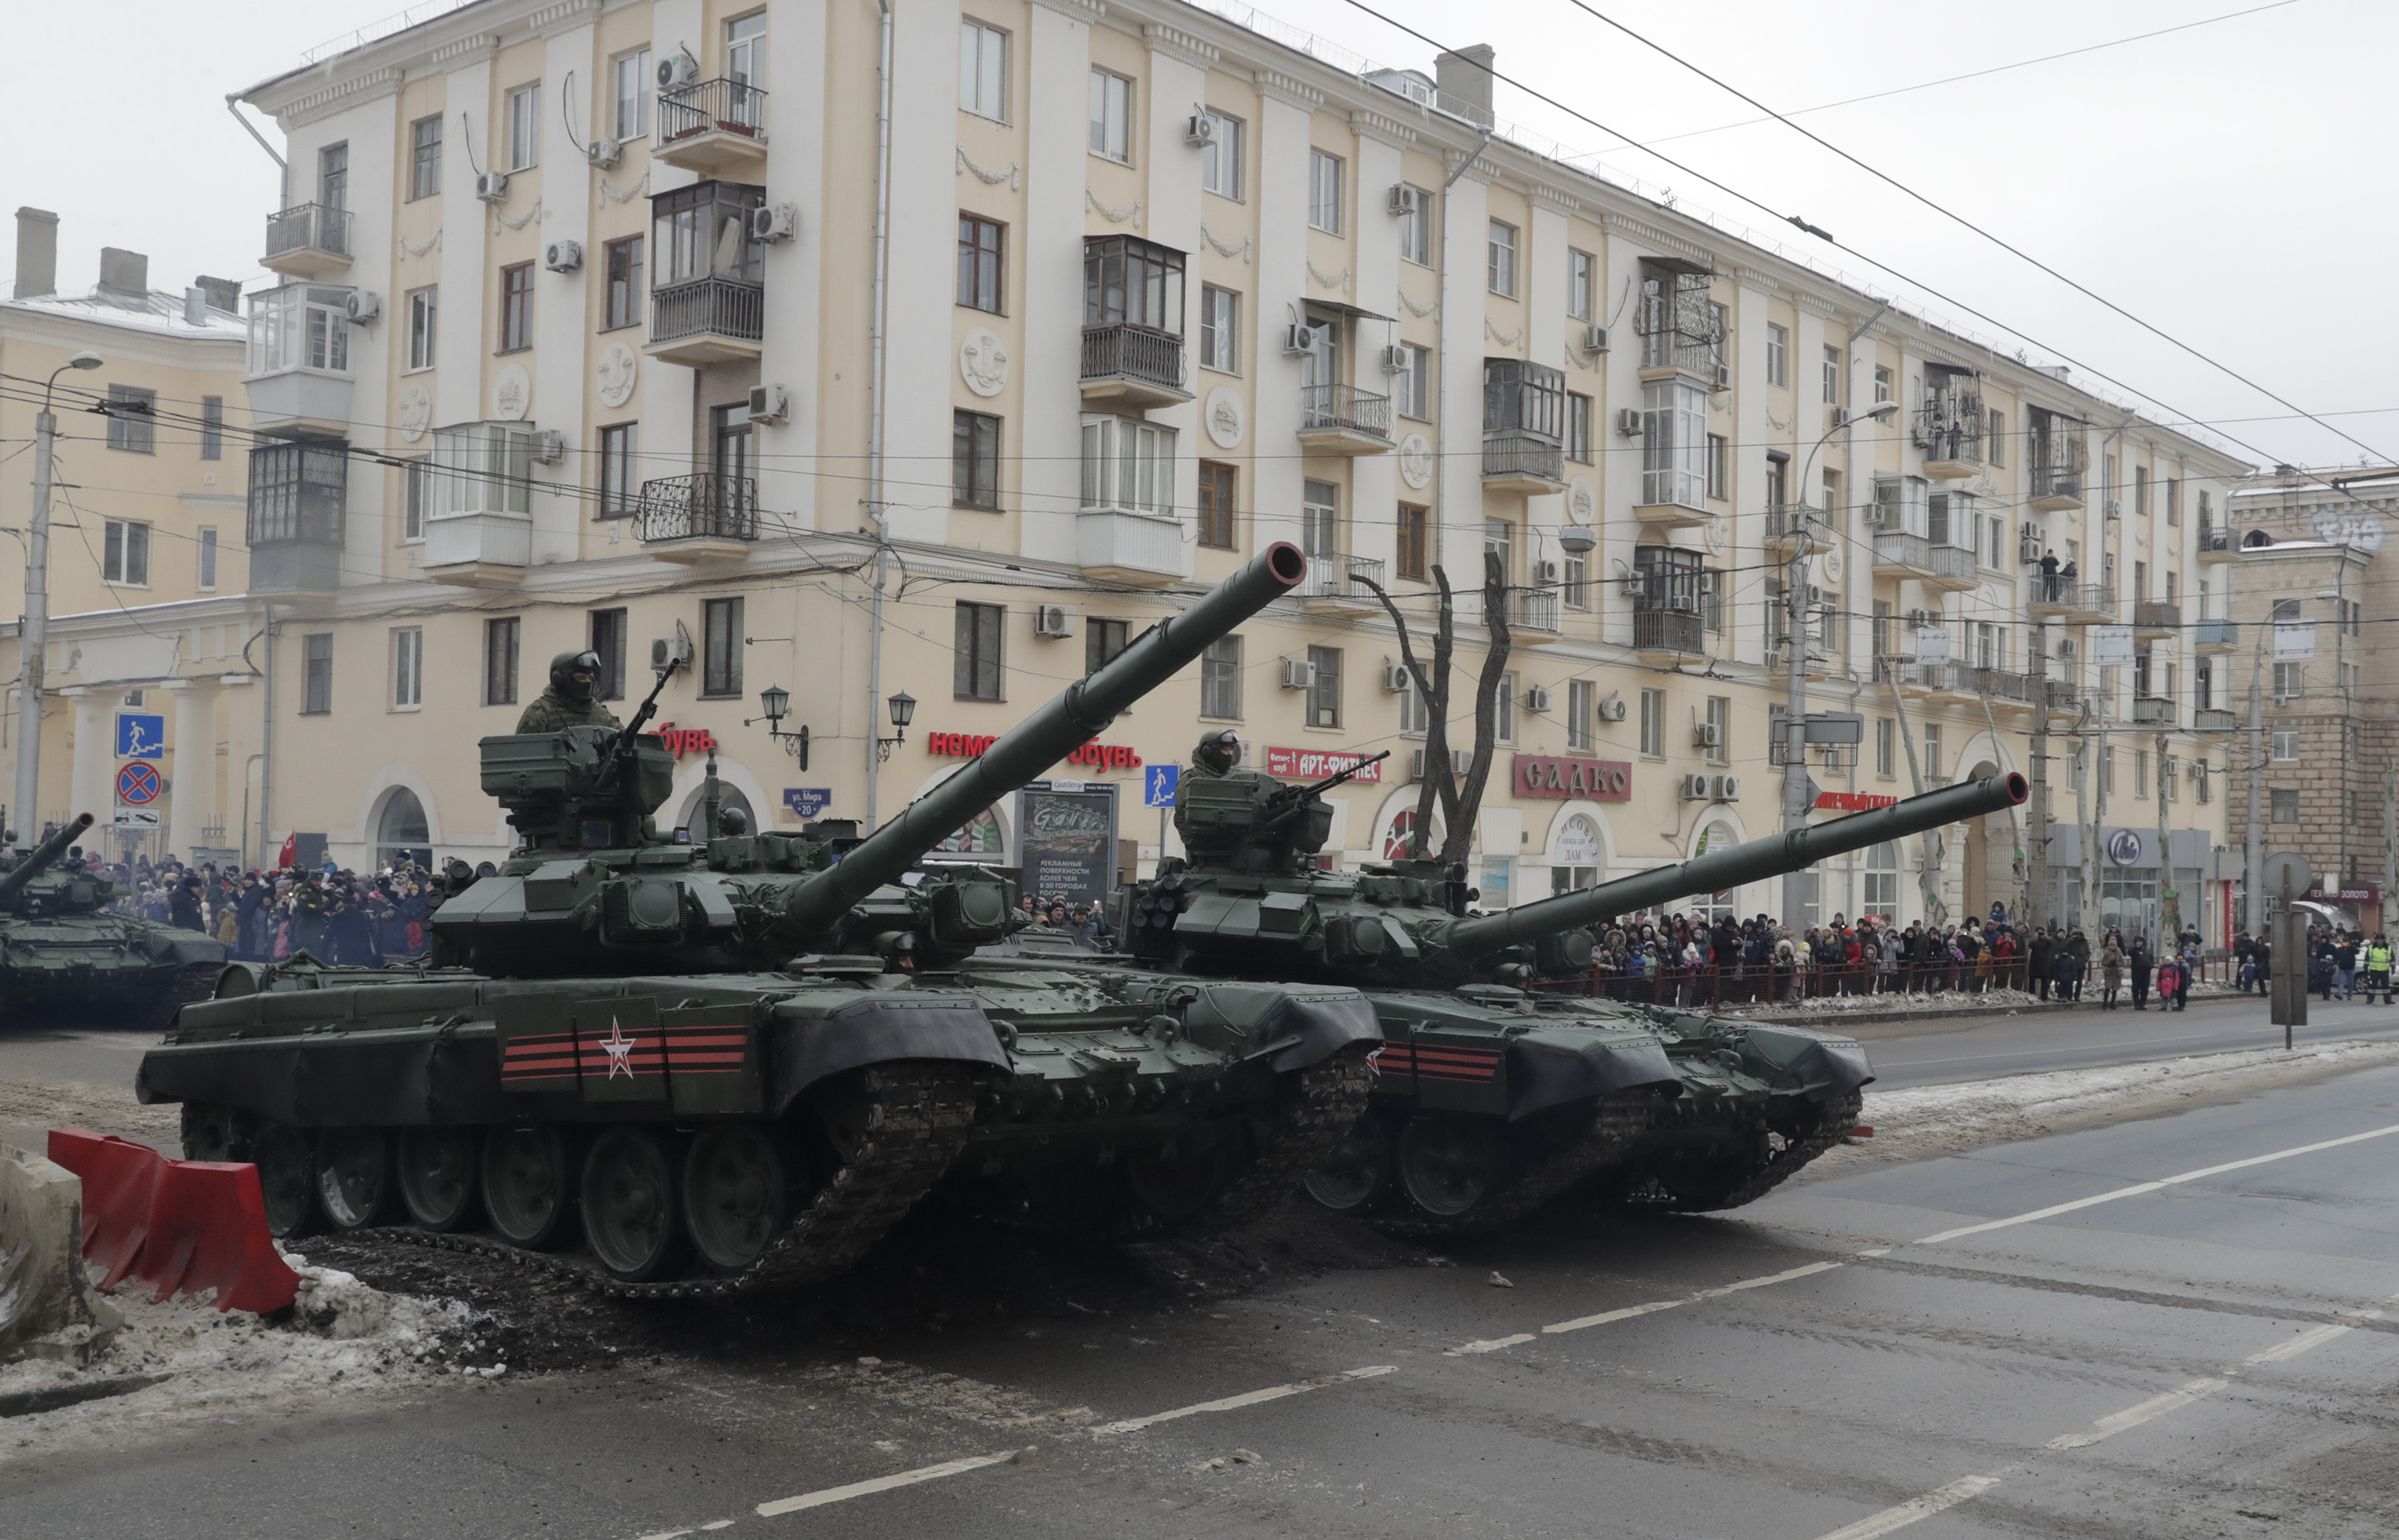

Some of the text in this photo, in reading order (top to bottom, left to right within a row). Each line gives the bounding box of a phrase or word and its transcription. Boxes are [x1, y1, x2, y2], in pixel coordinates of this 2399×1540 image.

[647, 722, 717, 759] бувь
[1273, 763, 1287, 774] клуб
[1525, 762, 1627, 795] САДКО
[1053, 779, 1084, 792] Gallery
[792, 792, 822, 803] ул. Мира
[801, 805, 812, 815] 20
[1565, 849, 1582, 863] ДАМ
[2341, 890, 2369, 899] ЗОЛОТО
